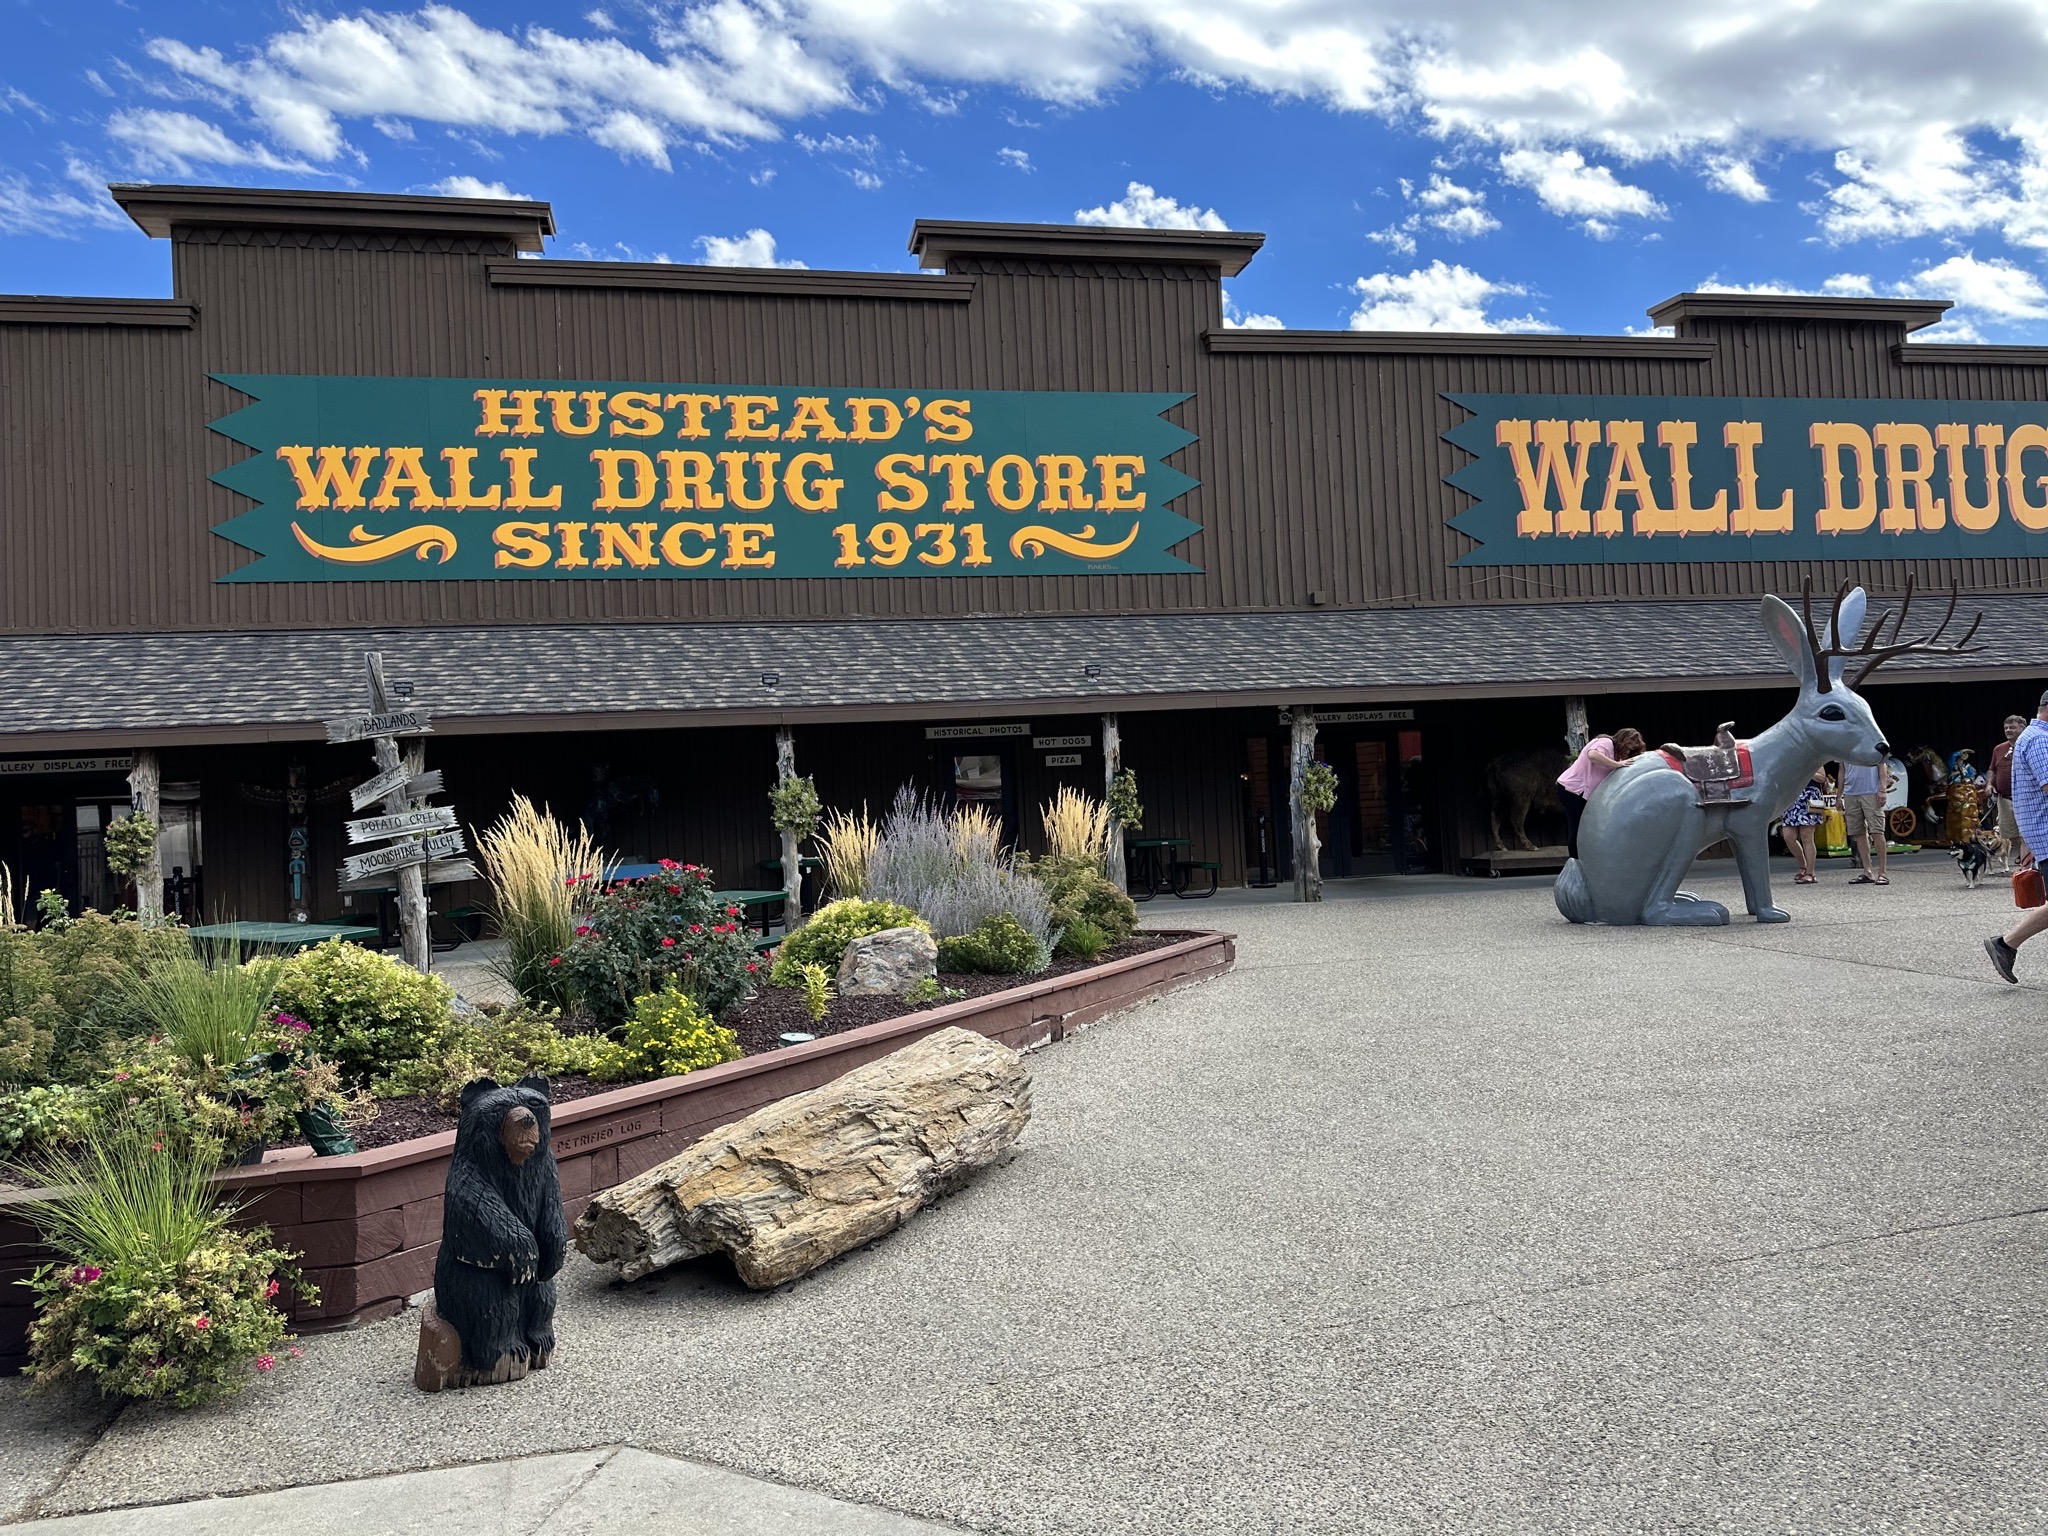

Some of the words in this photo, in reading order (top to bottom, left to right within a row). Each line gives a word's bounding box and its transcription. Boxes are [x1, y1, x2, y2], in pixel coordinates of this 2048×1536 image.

[473, 388, 974, 444] HUSTEAD'S
[276, 444, 562, 514] WALL
[590, 447, 844, 514] DRUG
[875, 452, 1147, 515] STORE
[1496, 417, 1794, 539] WALL
[1809, 420, 2048, 537] DRUG
[492, 520, 776, 571] SINCE
[833, 521, 992, 569] 1931
[363, 712, 417, 732] BADLANDS
[1347, 712, 1383, 720] DISPLAYS
[1388, 711, 1407, 719] FREE
[933, 727, 983, 737] HISTORICAL
[990, 725, 1023, 734] PHOTOS
[1038, 738, 1056, 746] HOT
[1062, 737, 1086, 745] DOGS
[0, 762, 35, 772] LLERY
[44, 760, 97, 771] DISPLAYS
[104, 759, 131, 769] FREE
[1051, 756, 1076, 764] PIZZA
[361, 816, 402, 833] POTATO
[409, 811, 442, 826] CREEK
[360, 844, 419, 869] MOONSHINE
[556, 1127, 614, 1153] PETRIFIED
[620, 1120, 642, 1134] LOG
